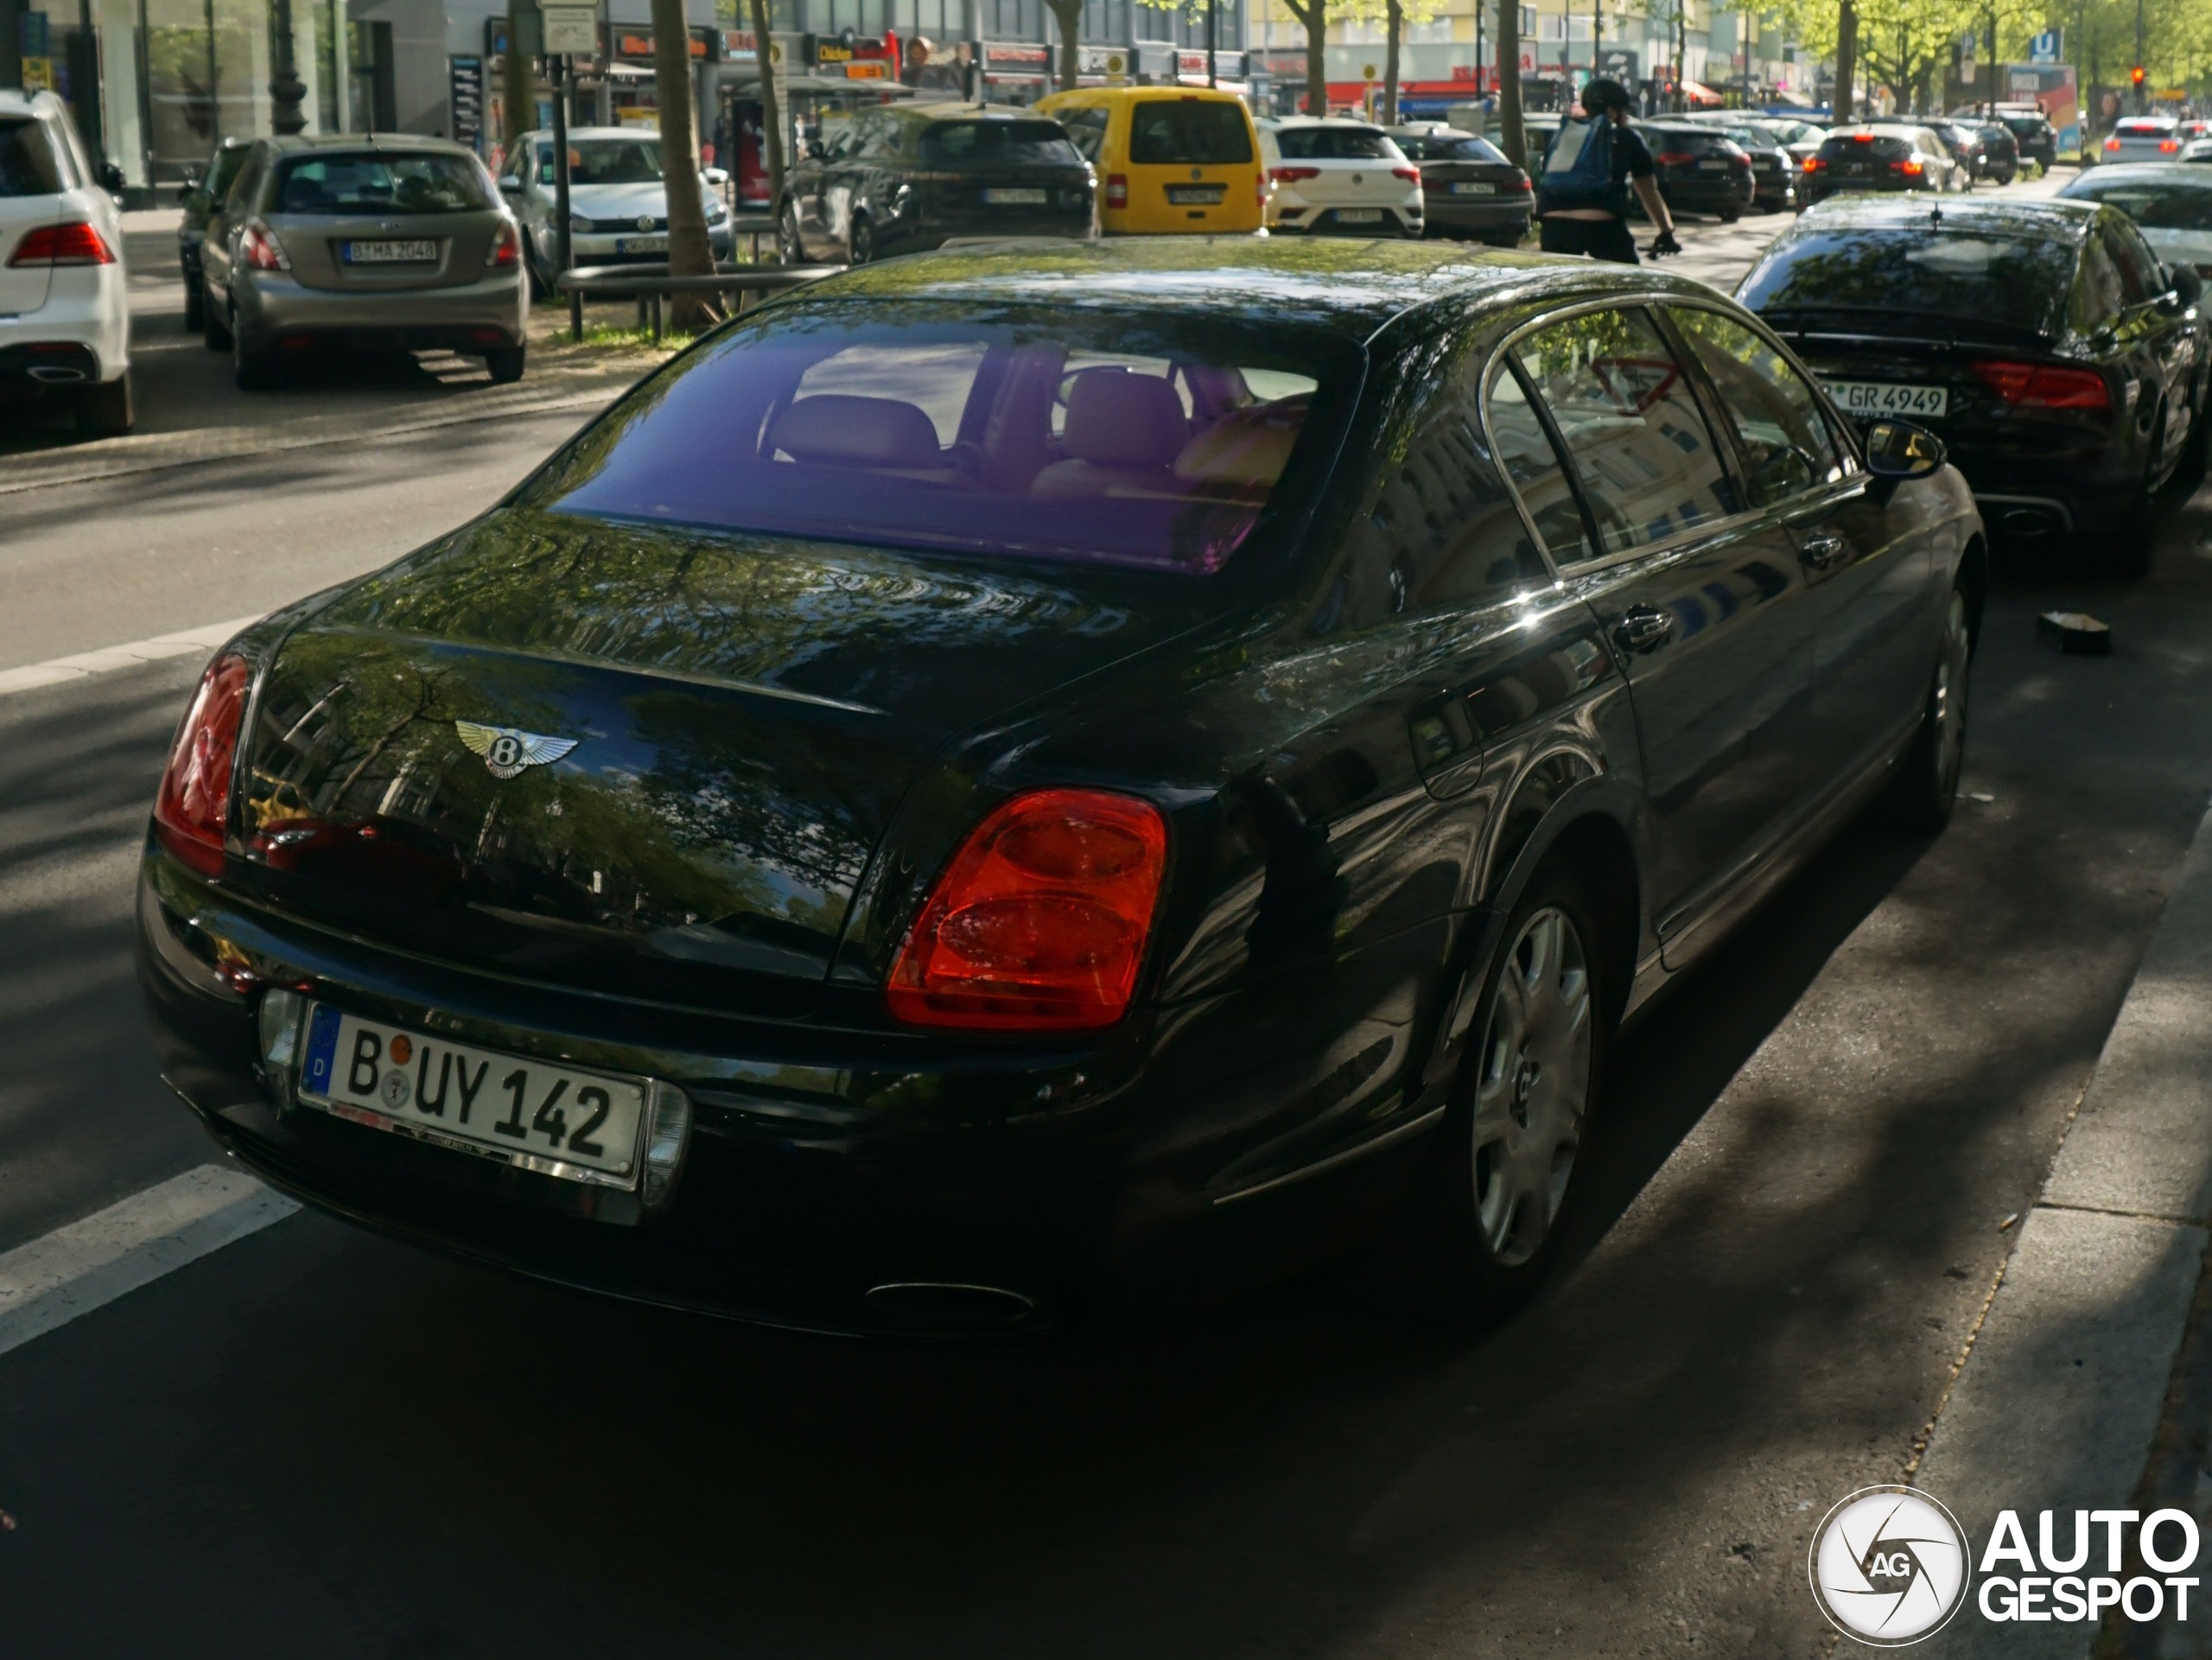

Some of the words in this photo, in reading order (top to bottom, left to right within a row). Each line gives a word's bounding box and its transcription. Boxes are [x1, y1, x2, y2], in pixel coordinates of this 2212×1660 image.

[2035, 33, 2054, 54] U
[353, 245, 363, 258] B
[1848, 385, 1878, 409] GR
[1883, 387, 1942, 412] 4949
[313, 1059, 324, 1077] D
[347, 1028, 382, 1096] B
[415, 1046, 489, 1123] UY
[493, 1069, 610, 1158] 142
